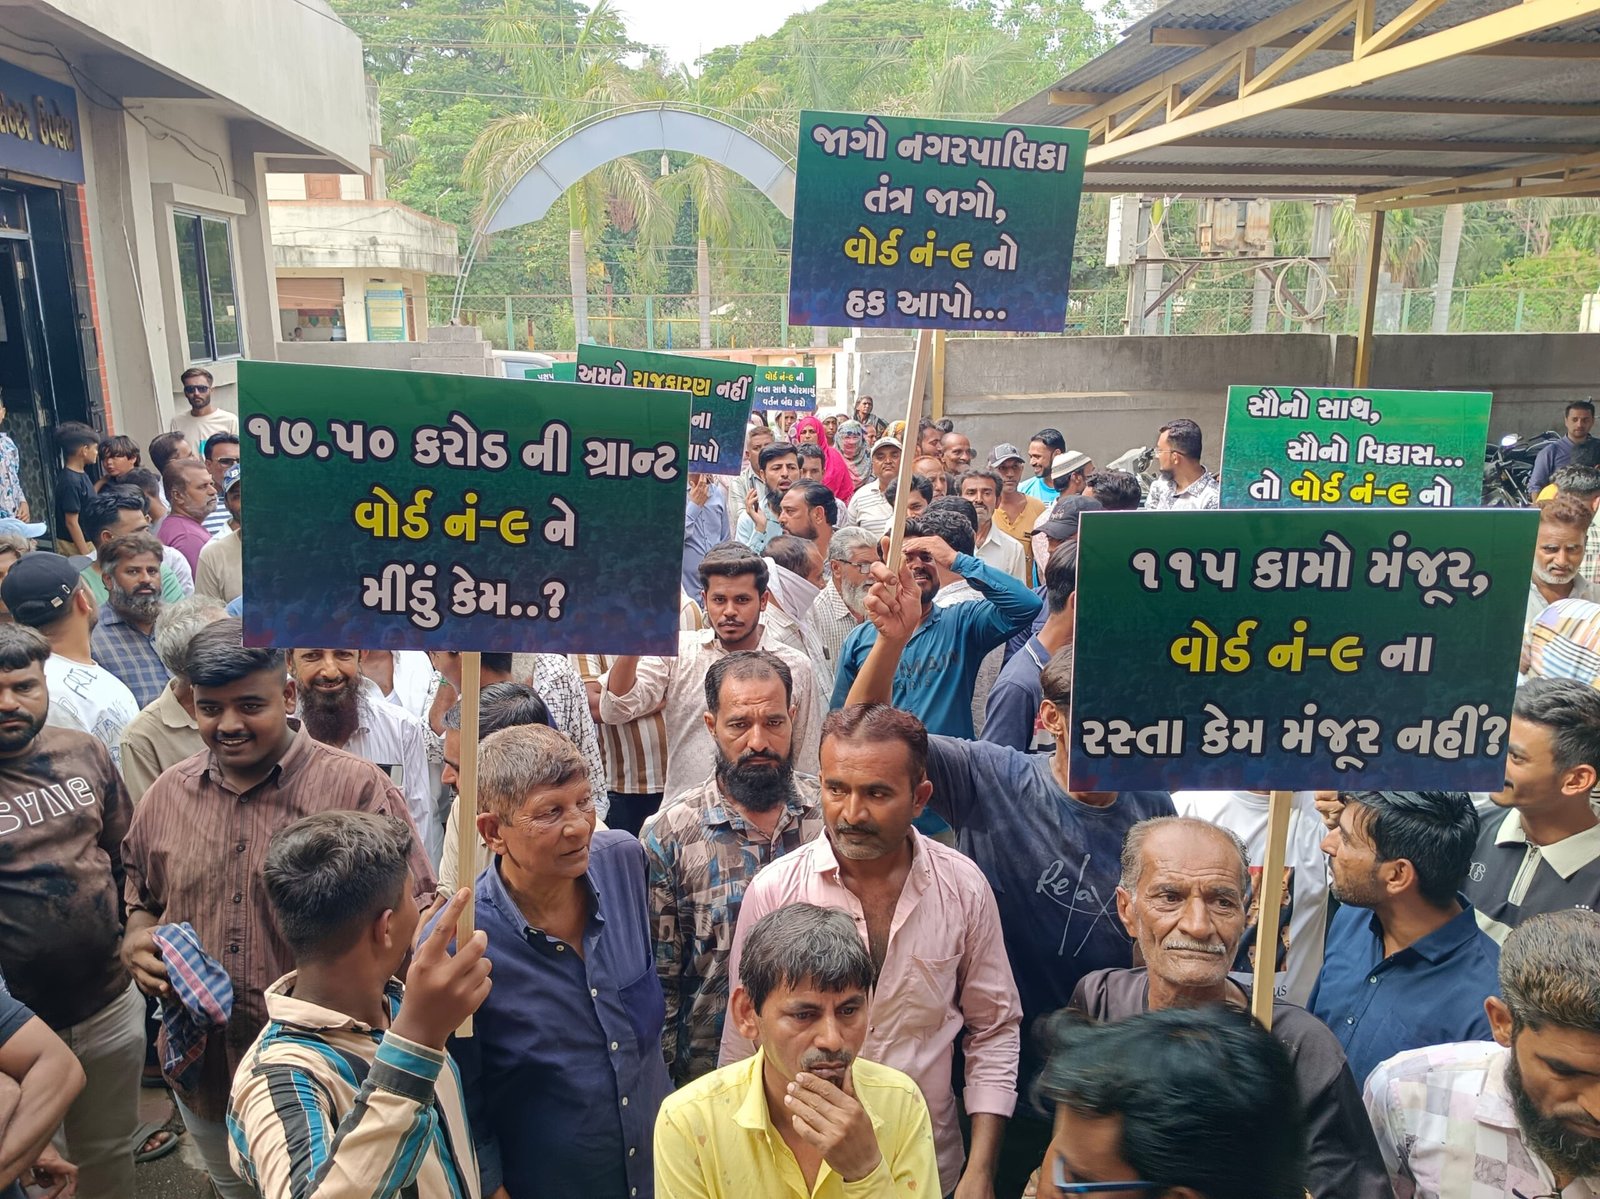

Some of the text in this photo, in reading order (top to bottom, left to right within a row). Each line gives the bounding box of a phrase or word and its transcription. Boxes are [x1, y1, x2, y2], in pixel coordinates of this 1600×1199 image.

[813, 118, 1067, 171] જાગો નગરપાલિકા
[864, 174, 1007, 225] તંત્ર જાગો,
[844, 227, 1018, 270] વોર્ડ નં-૯ નો
[845, 281, 1007, 320] હક આપો...
[578, 361, 752, 401] અમને રાજકારણ નહીં
[755, 385, 771, 393] નતા
[772, 384, 787, 394] સાથે
[765, 371, 804, 381] વોર્ડ નં-૯ ની
[763, 396, 779, 406] વર્તન
[794, 397, 806, 407] કરો
[1248, 388, 1380, 424] સૌનો સાથ,
[248, 414, 678, 480] ૧૭.૫૦ કરોડ ની ગ્રાન્ટ
[1287, 433, 1464, 467] સૌનો વિકાસ...
[1249, 469, 1452, 507] તો વોર્ડ નં-૯ નો
[355, 486, 575, 547] વોર્ડ નં-૯ ને
[1132, 534, 1489, 605] ૧૧૫ કામો મંજૂર,
[363, 563, 566, 628] મીંડું કેમ..?
[1170, 620, 1433, 672] વોર્ડ નં-૯ ના
[1082, 703, 1508, 770] રસ્તા કેમ મંજૂર નહીં?
